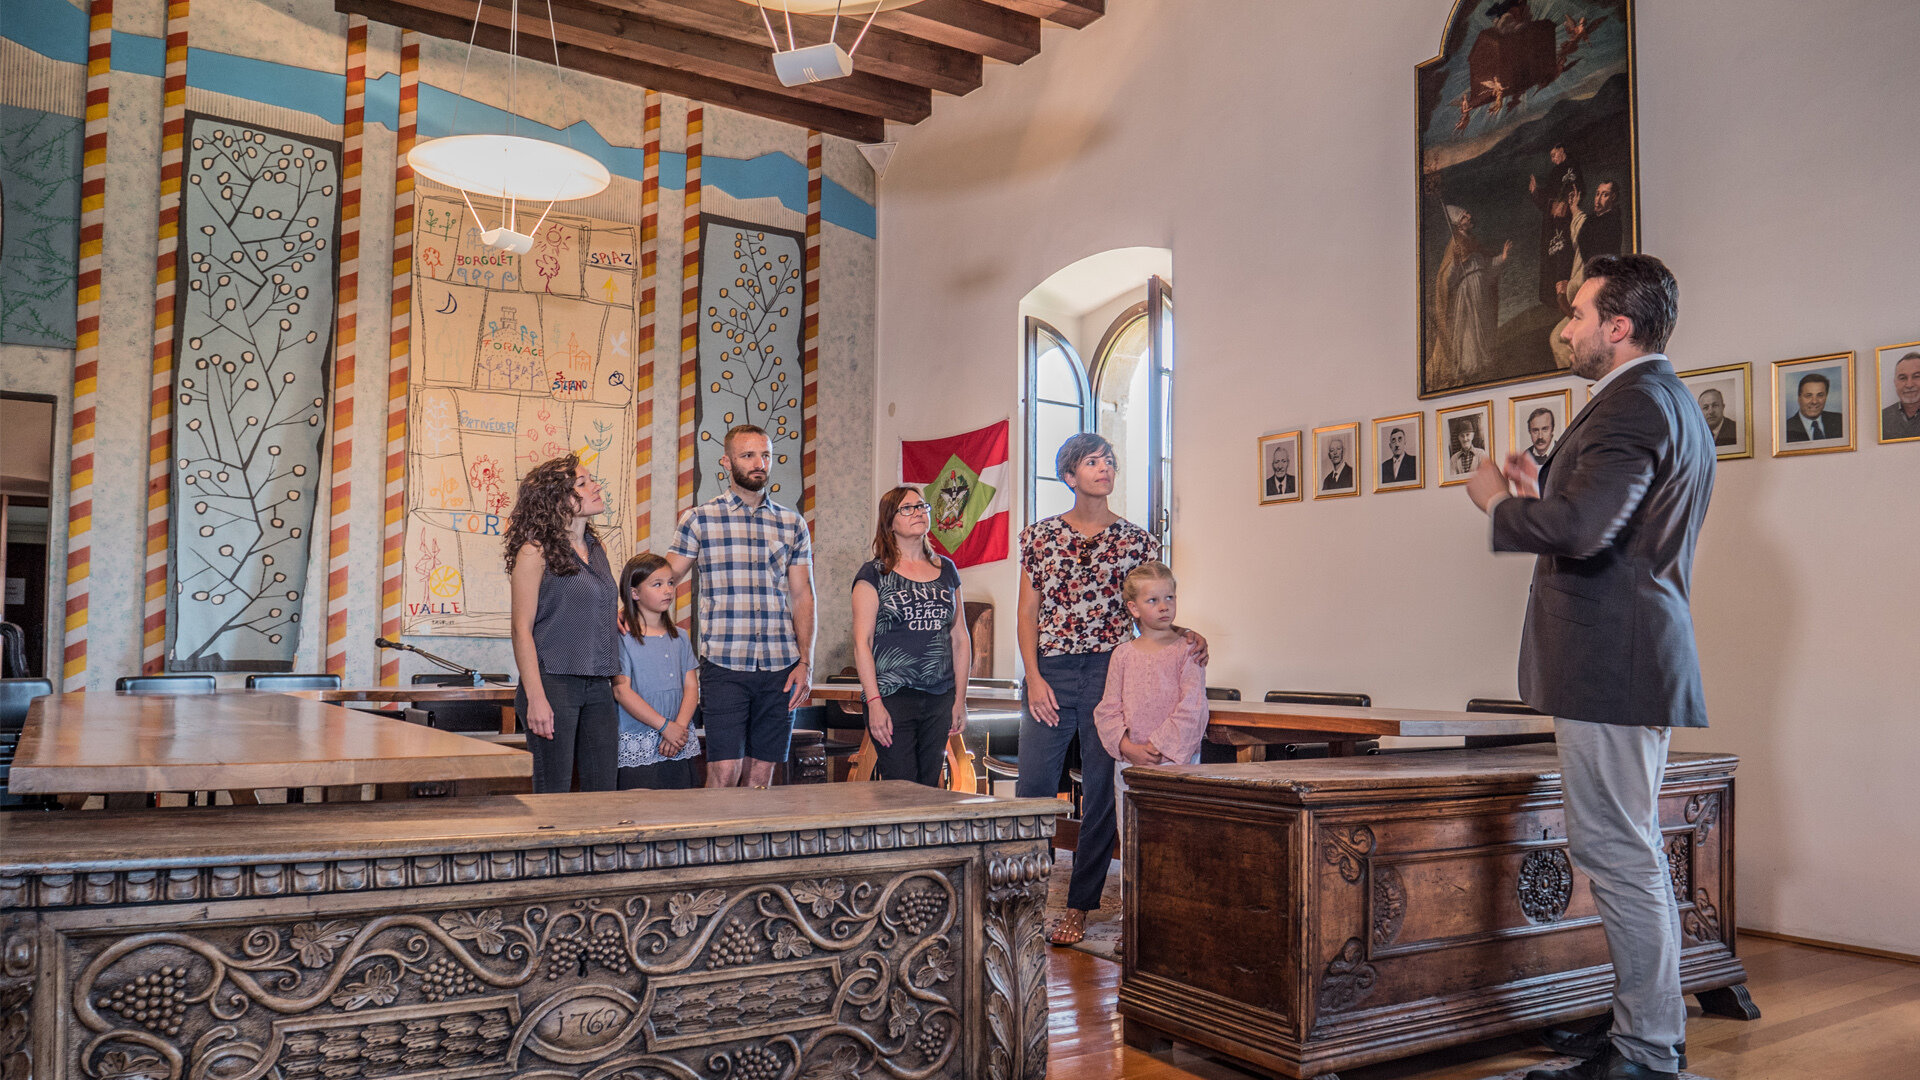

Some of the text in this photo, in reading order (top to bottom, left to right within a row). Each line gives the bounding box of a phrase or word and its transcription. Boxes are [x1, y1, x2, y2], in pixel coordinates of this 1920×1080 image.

[456, 250, 513, 267] BORGOLÉT
[590, 251, 632, 265] SPIAZ
[482, 339, 543, 357] FORNACE
[552, 380, 588, 395] STEFANO
[884, 587, 952, 611] VENIC
[408, 601, 462, 616] VALLE
[902, 606, 948, 620] BEACH
[908, 620, 942, 631] CLUB
